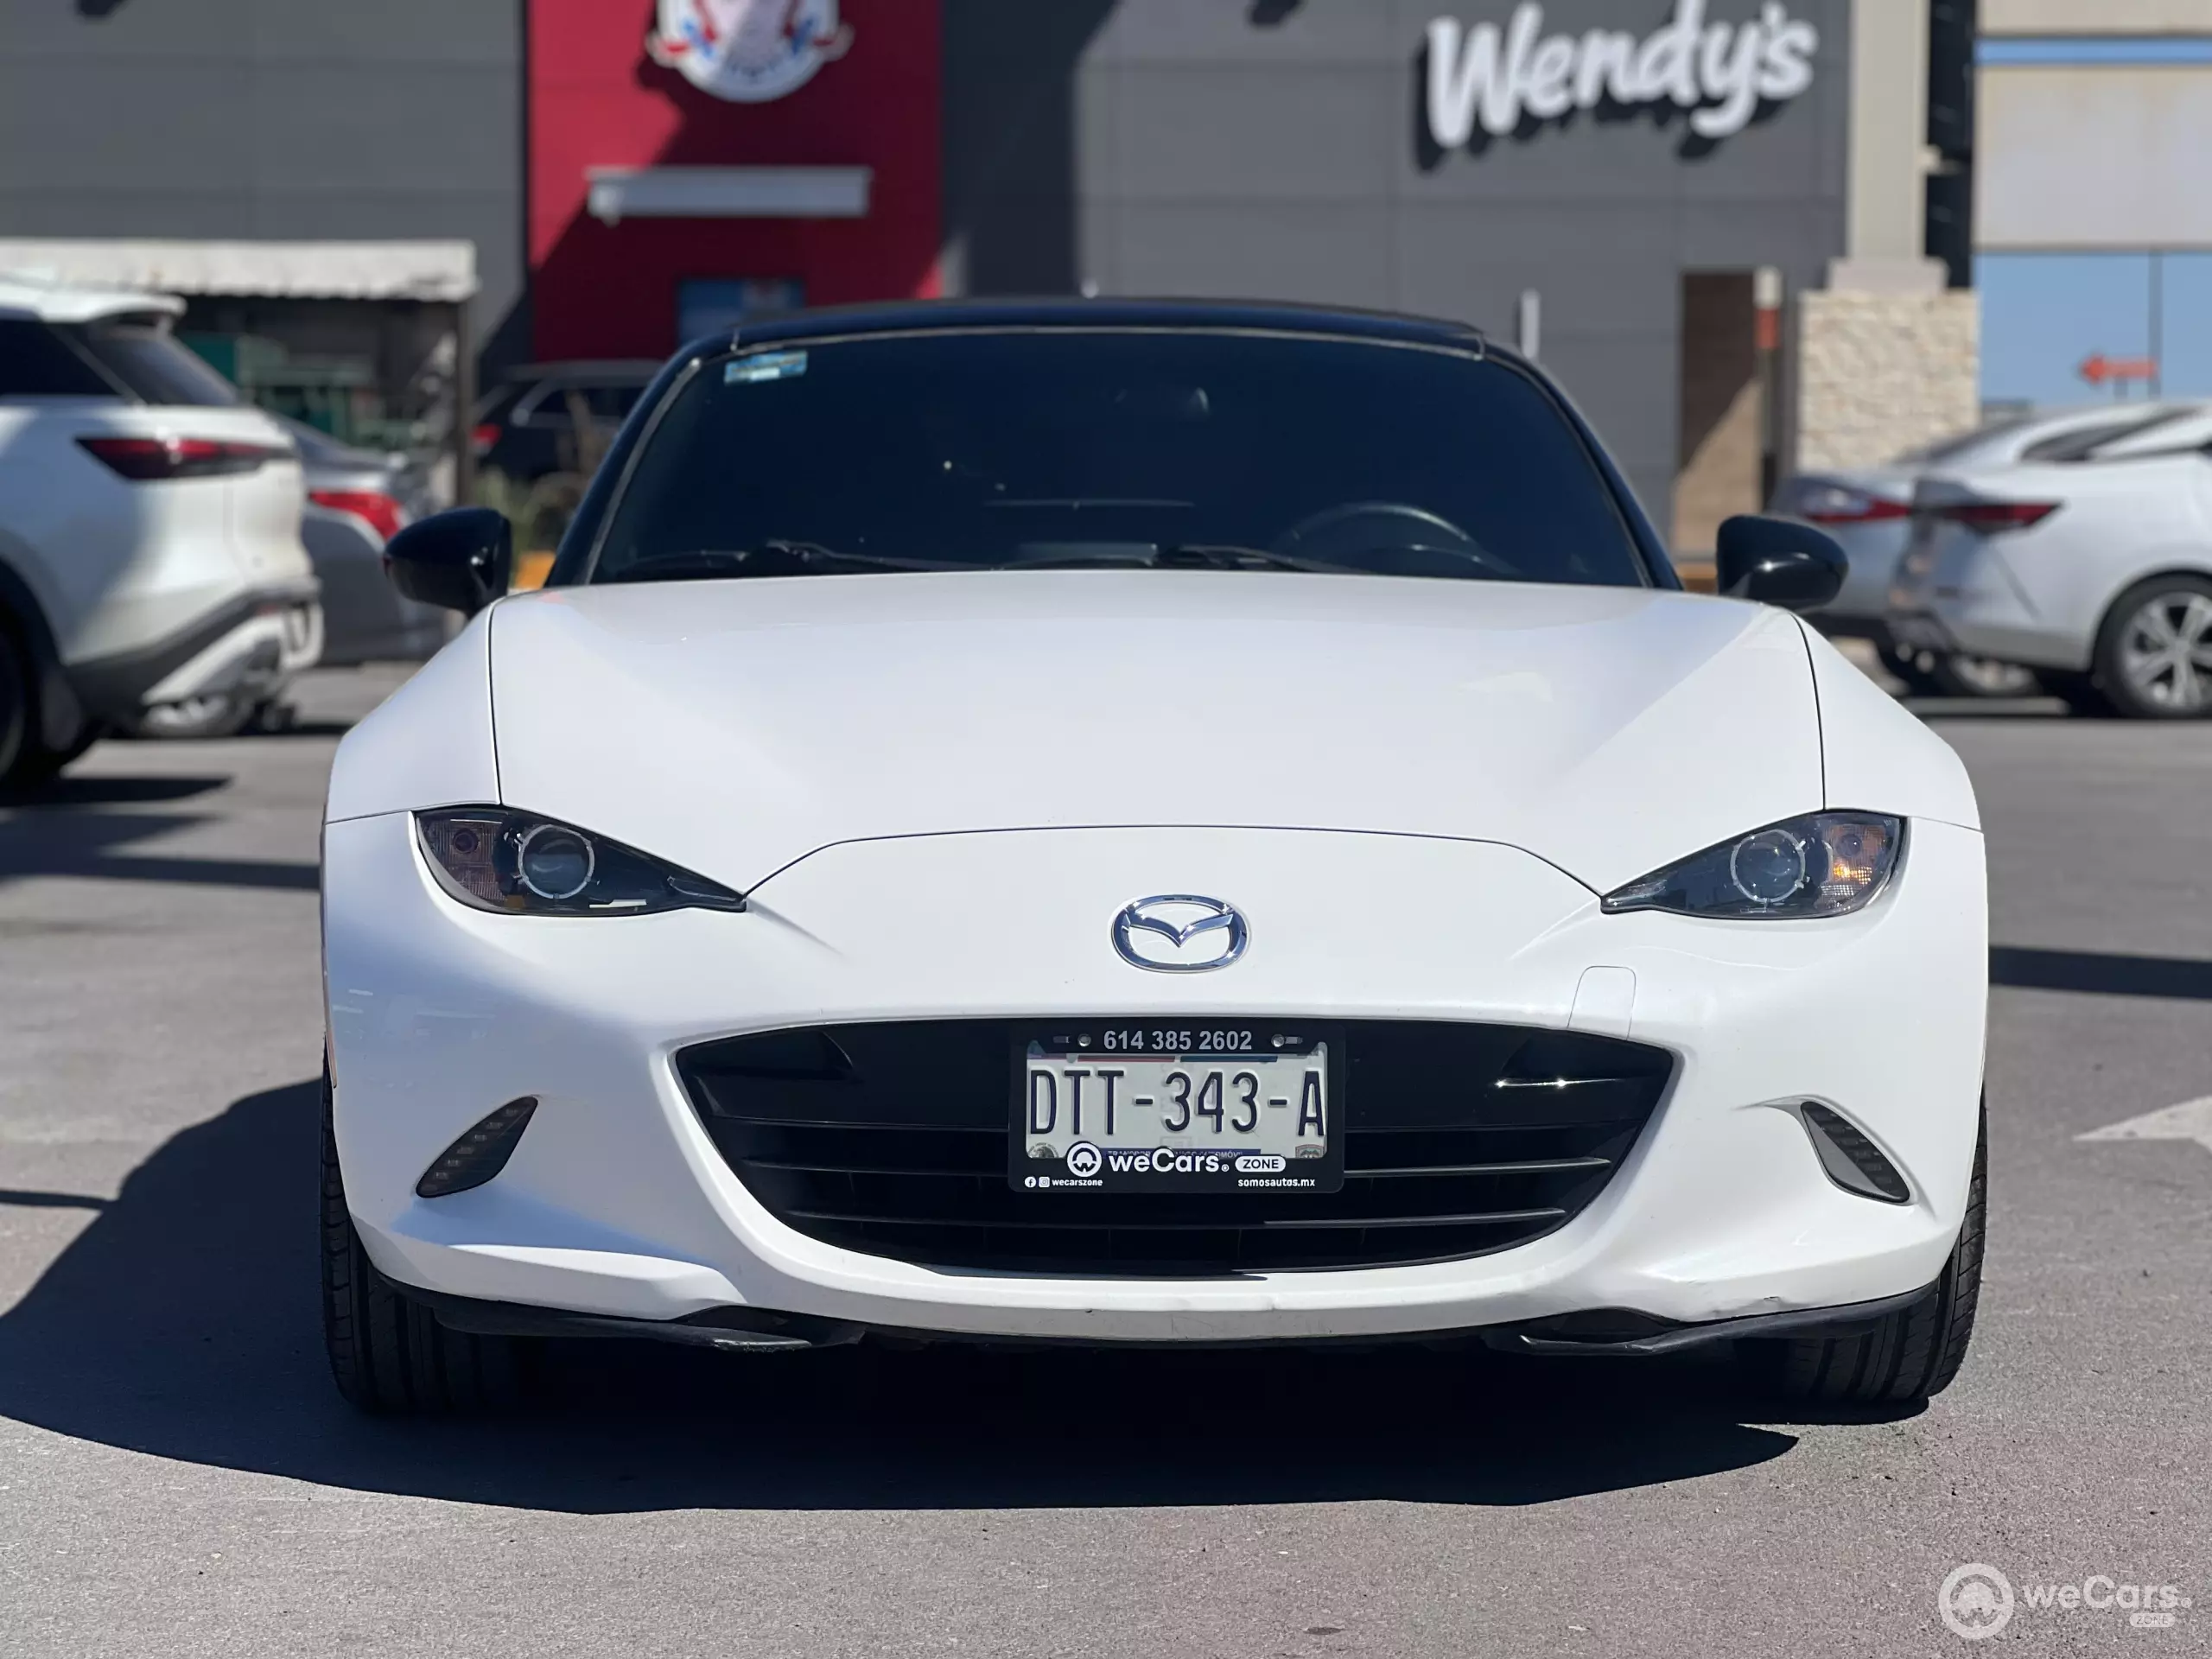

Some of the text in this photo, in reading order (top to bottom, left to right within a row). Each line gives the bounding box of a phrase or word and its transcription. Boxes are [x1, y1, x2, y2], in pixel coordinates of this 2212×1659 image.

[1427, 0, 1818, 149] Wendy's
[1103, 1030, 1253, 1050] 614 385 2602
[1029, 1070, 1325, 1137] DTT-343-A
[1243, 1159, 1279, 1169] ZONE
[1237, 1177, 1316, 1187] somosautos.mx
